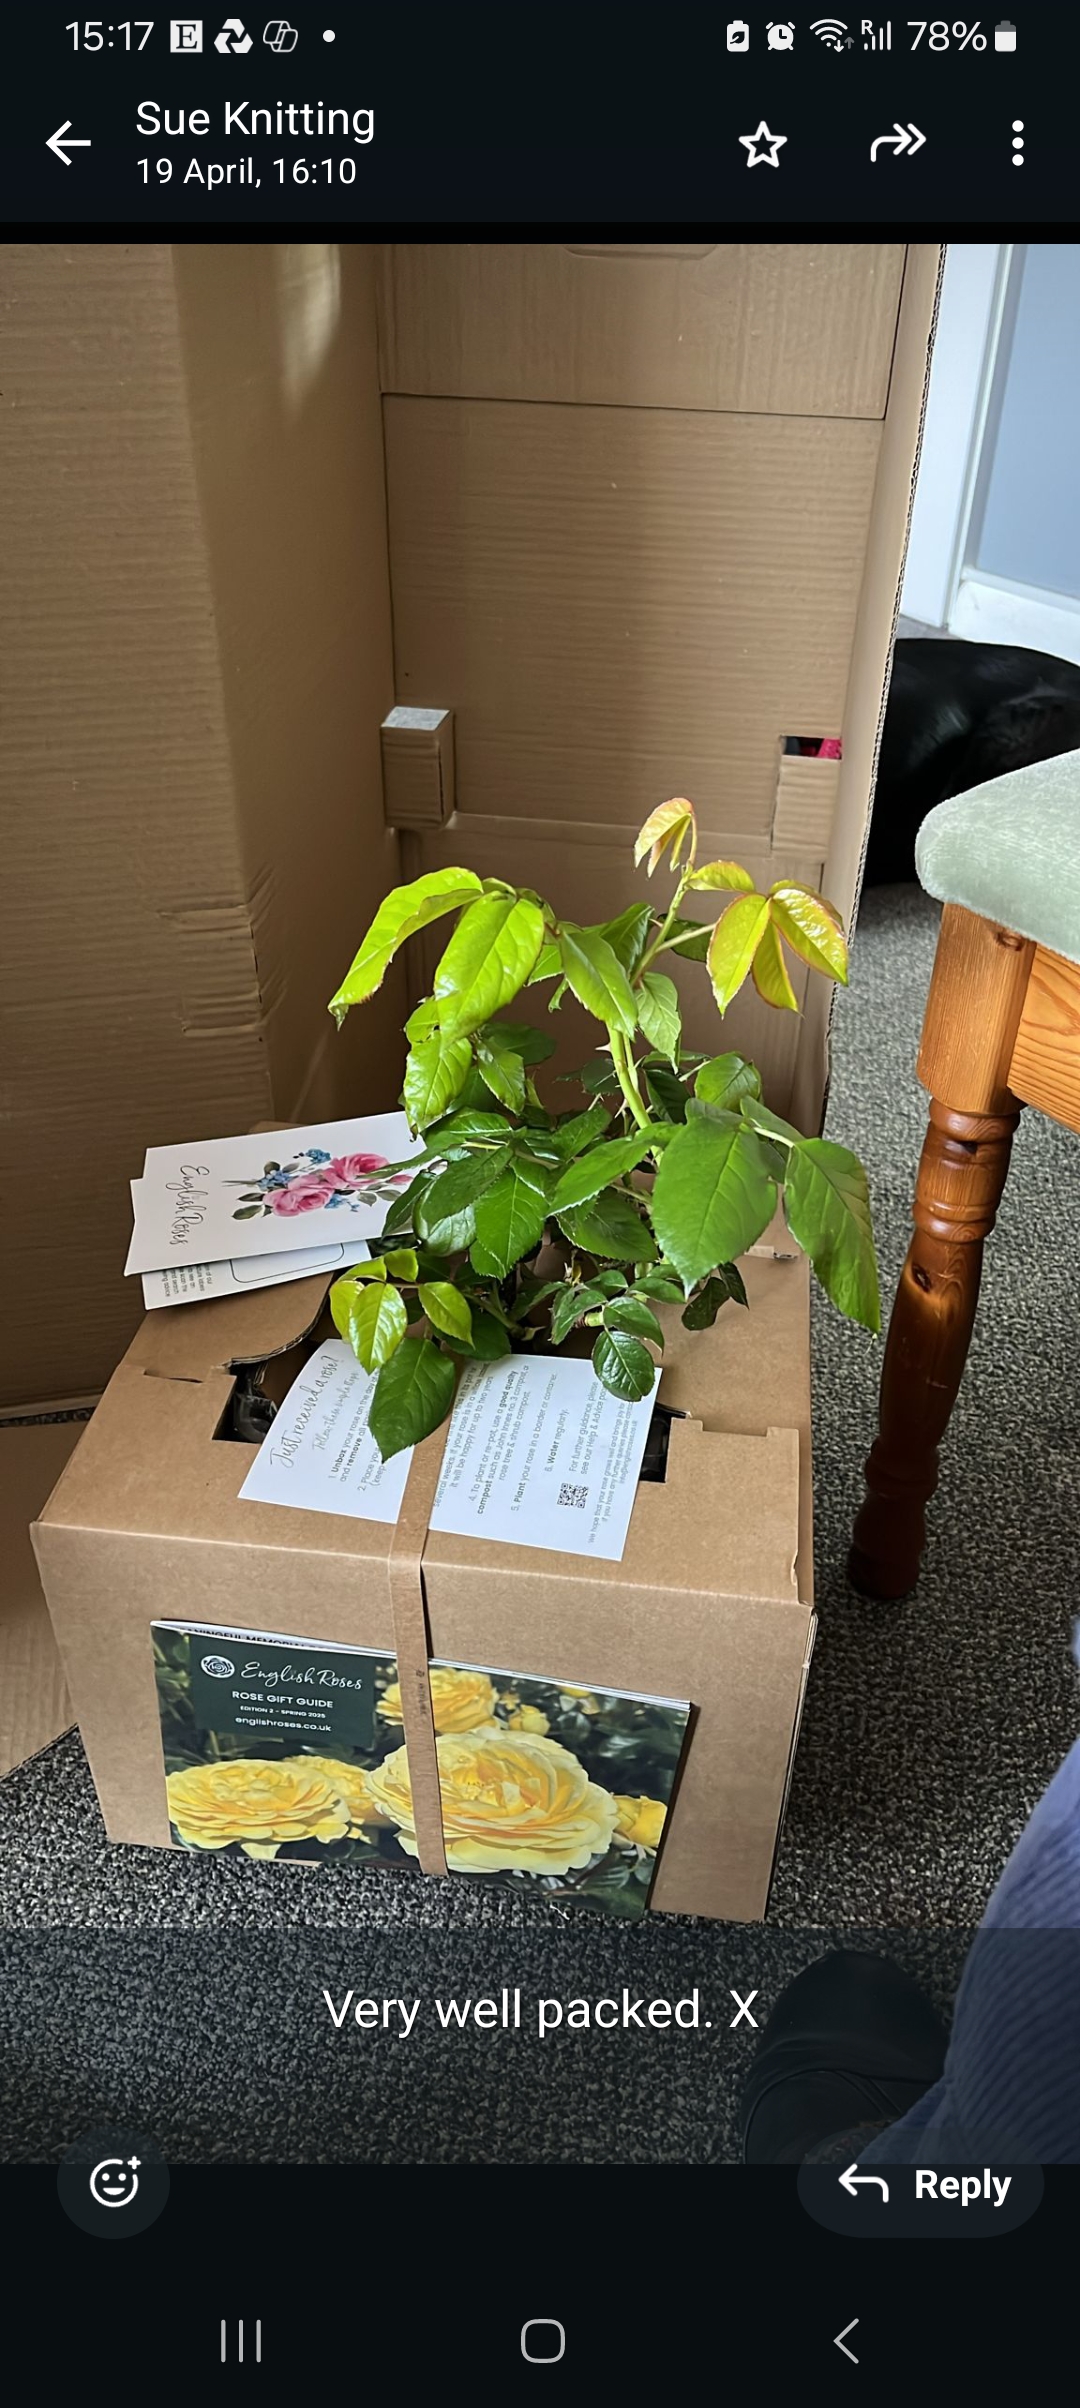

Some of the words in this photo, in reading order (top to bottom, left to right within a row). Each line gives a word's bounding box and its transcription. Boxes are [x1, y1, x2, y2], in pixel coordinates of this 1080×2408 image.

[165, 1165, 210, 1214] English
[169, 1212, 204, 1245] Roses
[359, 1394, 369, 1405] the
[477, 1392, 487, 1404] two
[587, 1381, 598, 1402] please
[270, 1431, 301, 1467] Just
[293, 1385, 322, 1434] received
[320, 1355, 344, 1378] rose?
[356, 1405, 365, 1415] on
[472, 1412, 482, 1422] up
[592, 1400, 603, 1423] Advice
[349, 1416, 360, 1431] rose
[475, 1463, 487, 1483] plant
[484, 1429, 499, 1453] re-pot,
[492, 1415, 501, 1428] use
[499, 1391, 509, 1408] good
[505, 1371, 518, 1390] quality
[501, 1413, 513, 1431] Innes
[533, 1409, 545, 1432] border
[579, 1403, 595, 1435] guidance,
[467, 1423, 477, 1434] for
[510, 1420, 521, 1440] shrub
[547, 1441, 559, 1463] Water
[555, 1409, 569, 1440] regularly.
[342, 1432, 354, 1448] your
[460, 1434, 475, 1457] happy
[496, 1432, 507, 1450] John
[571, 1435, 584, 1459] further
[586, 1431, 598, 1447] Help
[331, 1450, 347, 1472] Unbox
[340, 1467, 350, 1482] and
[346, 1438, 362, 1466] remove
[358, 1427, 366, 1437] all
[432, 1482, 447, 1507] several
[453, 1432, 463, 1448] your
[458, 1416, 469, 1432] rose
[502, 1448, 513, 1463] tree
[525, 1448, 535, 1464] rose
[584, 1448, 592, 1460] our
[456, 1458, 466, 1468] be
[487, 1461, 498, 1479] such
[568, 1460, 578, 1472] For
[580, 1461, 589, 1474] see
[361, 1464, 375, 1484] Place
[453, 1469, 462, 1481] will
[498, 1464, 508, 1481] rose
[521, 1465, 531, 1481] your
[609, 1478, 618, 1490] any
[477, 1480, 492, 1514] compost
[513, 1482, 526, 1503] Plant
[598, 1490, 609, 1504] your
[604, 1490, 614, 1505] have
[594, 1504, 603, 1516] that
[603, 1505, 611, 1517] you
[590, 1517, 602, 1532] hope
[241, 1661, 316, 1687] English
[317, 1669, 362, 1690] Roses
[232, 1690, 264, 1702] ROSE
[266, 1695, 294, 1705] GIFT
[296, 1697, 334, 1709] GUIDE
[240, 1704, 268, 1714] EDITION
[281, 1709, 307, 1717] SPRING
[235, 1716, 332, 1732] englishroses.co.uk
